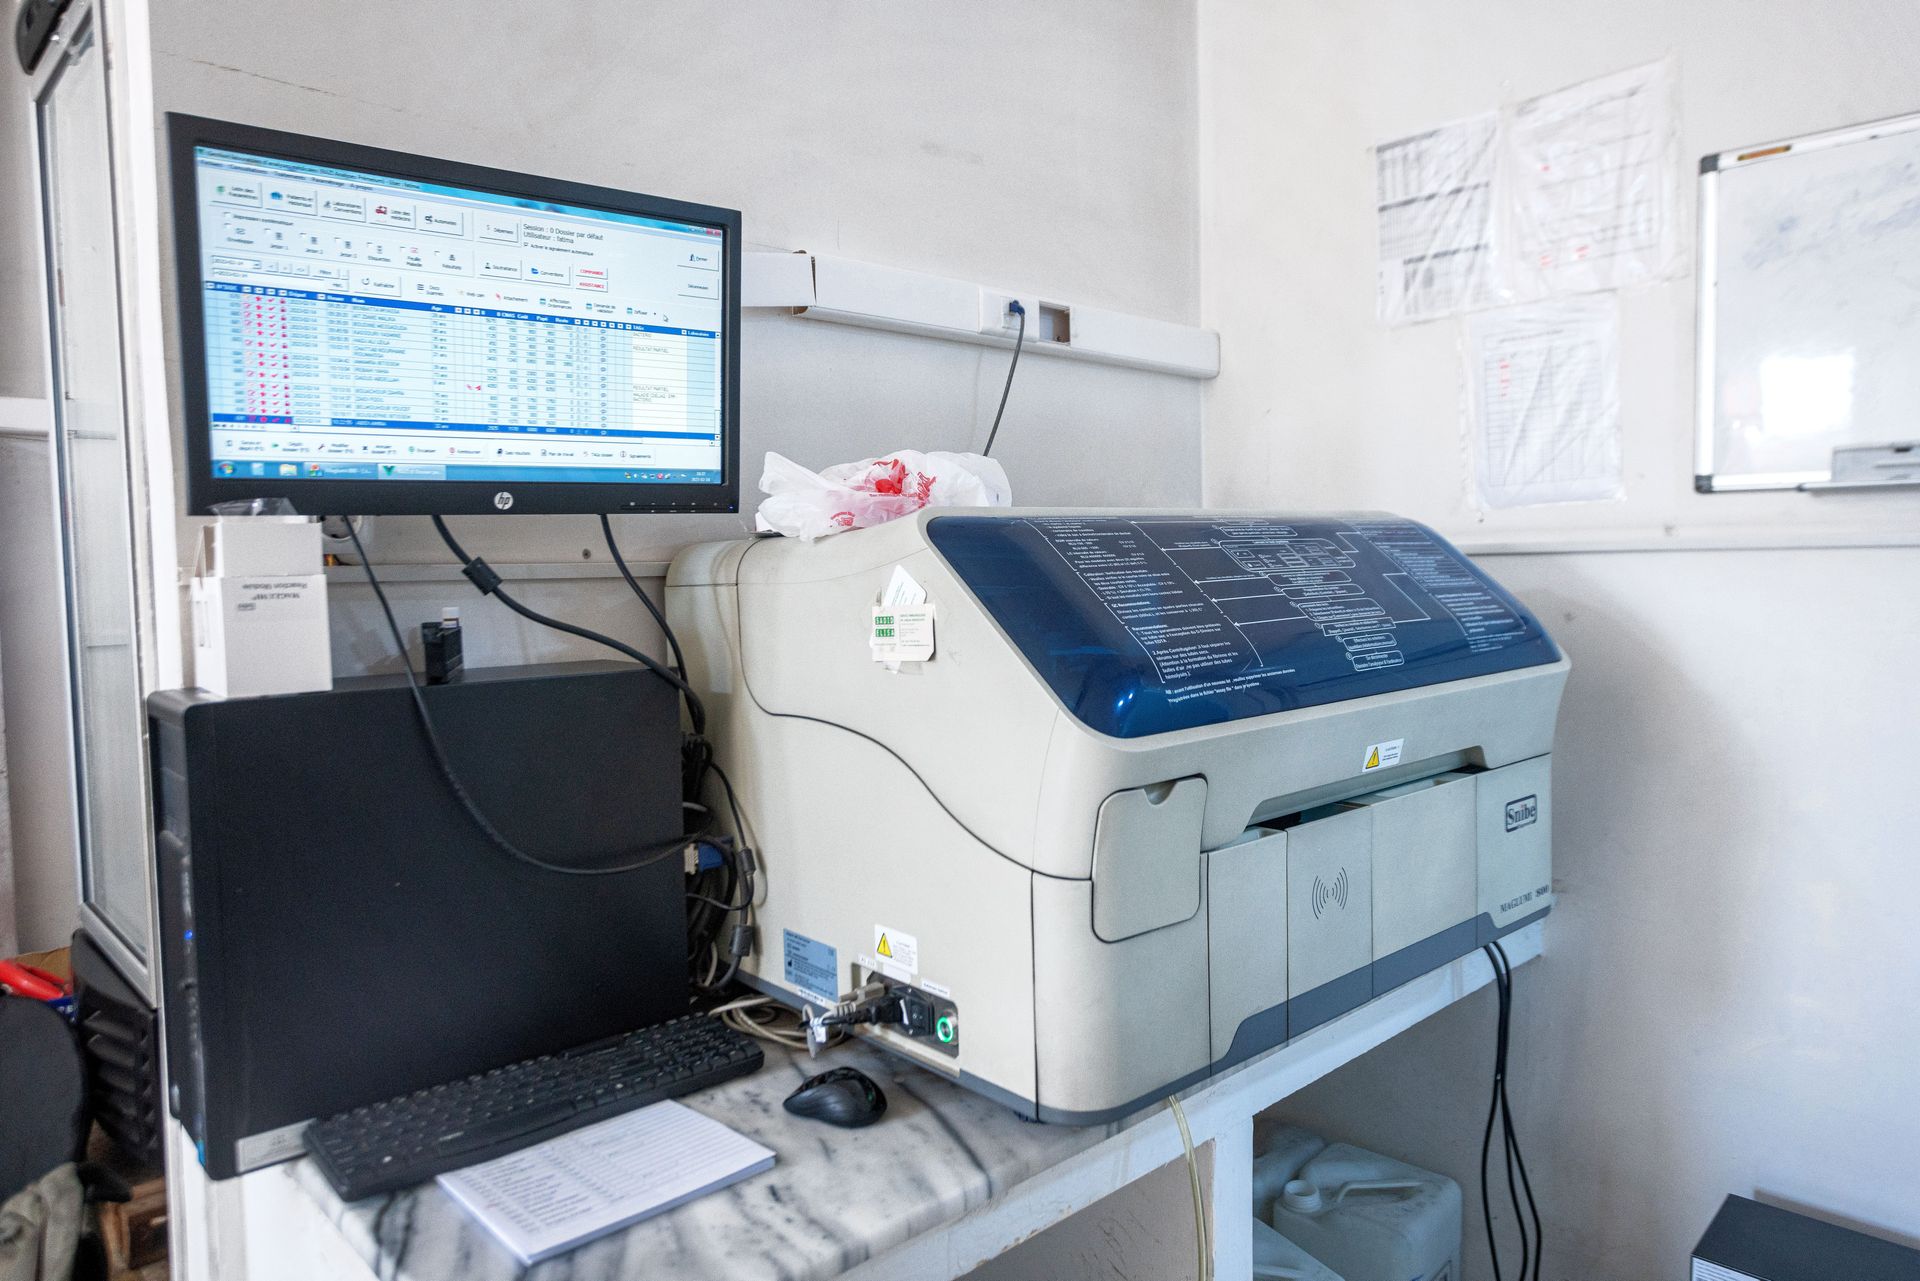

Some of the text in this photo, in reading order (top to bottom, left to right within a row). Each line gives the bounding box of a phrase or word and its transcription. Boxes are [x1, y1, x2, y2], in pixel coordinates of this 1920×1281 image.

[523, 223, 545, 232] Session
[555, 228, 575, 236] Dossier
[523, 231, 551, 240] Utilisateur
[496, 491, 512, 510] hp
[1507, 802, 1537, 825] Snibe
